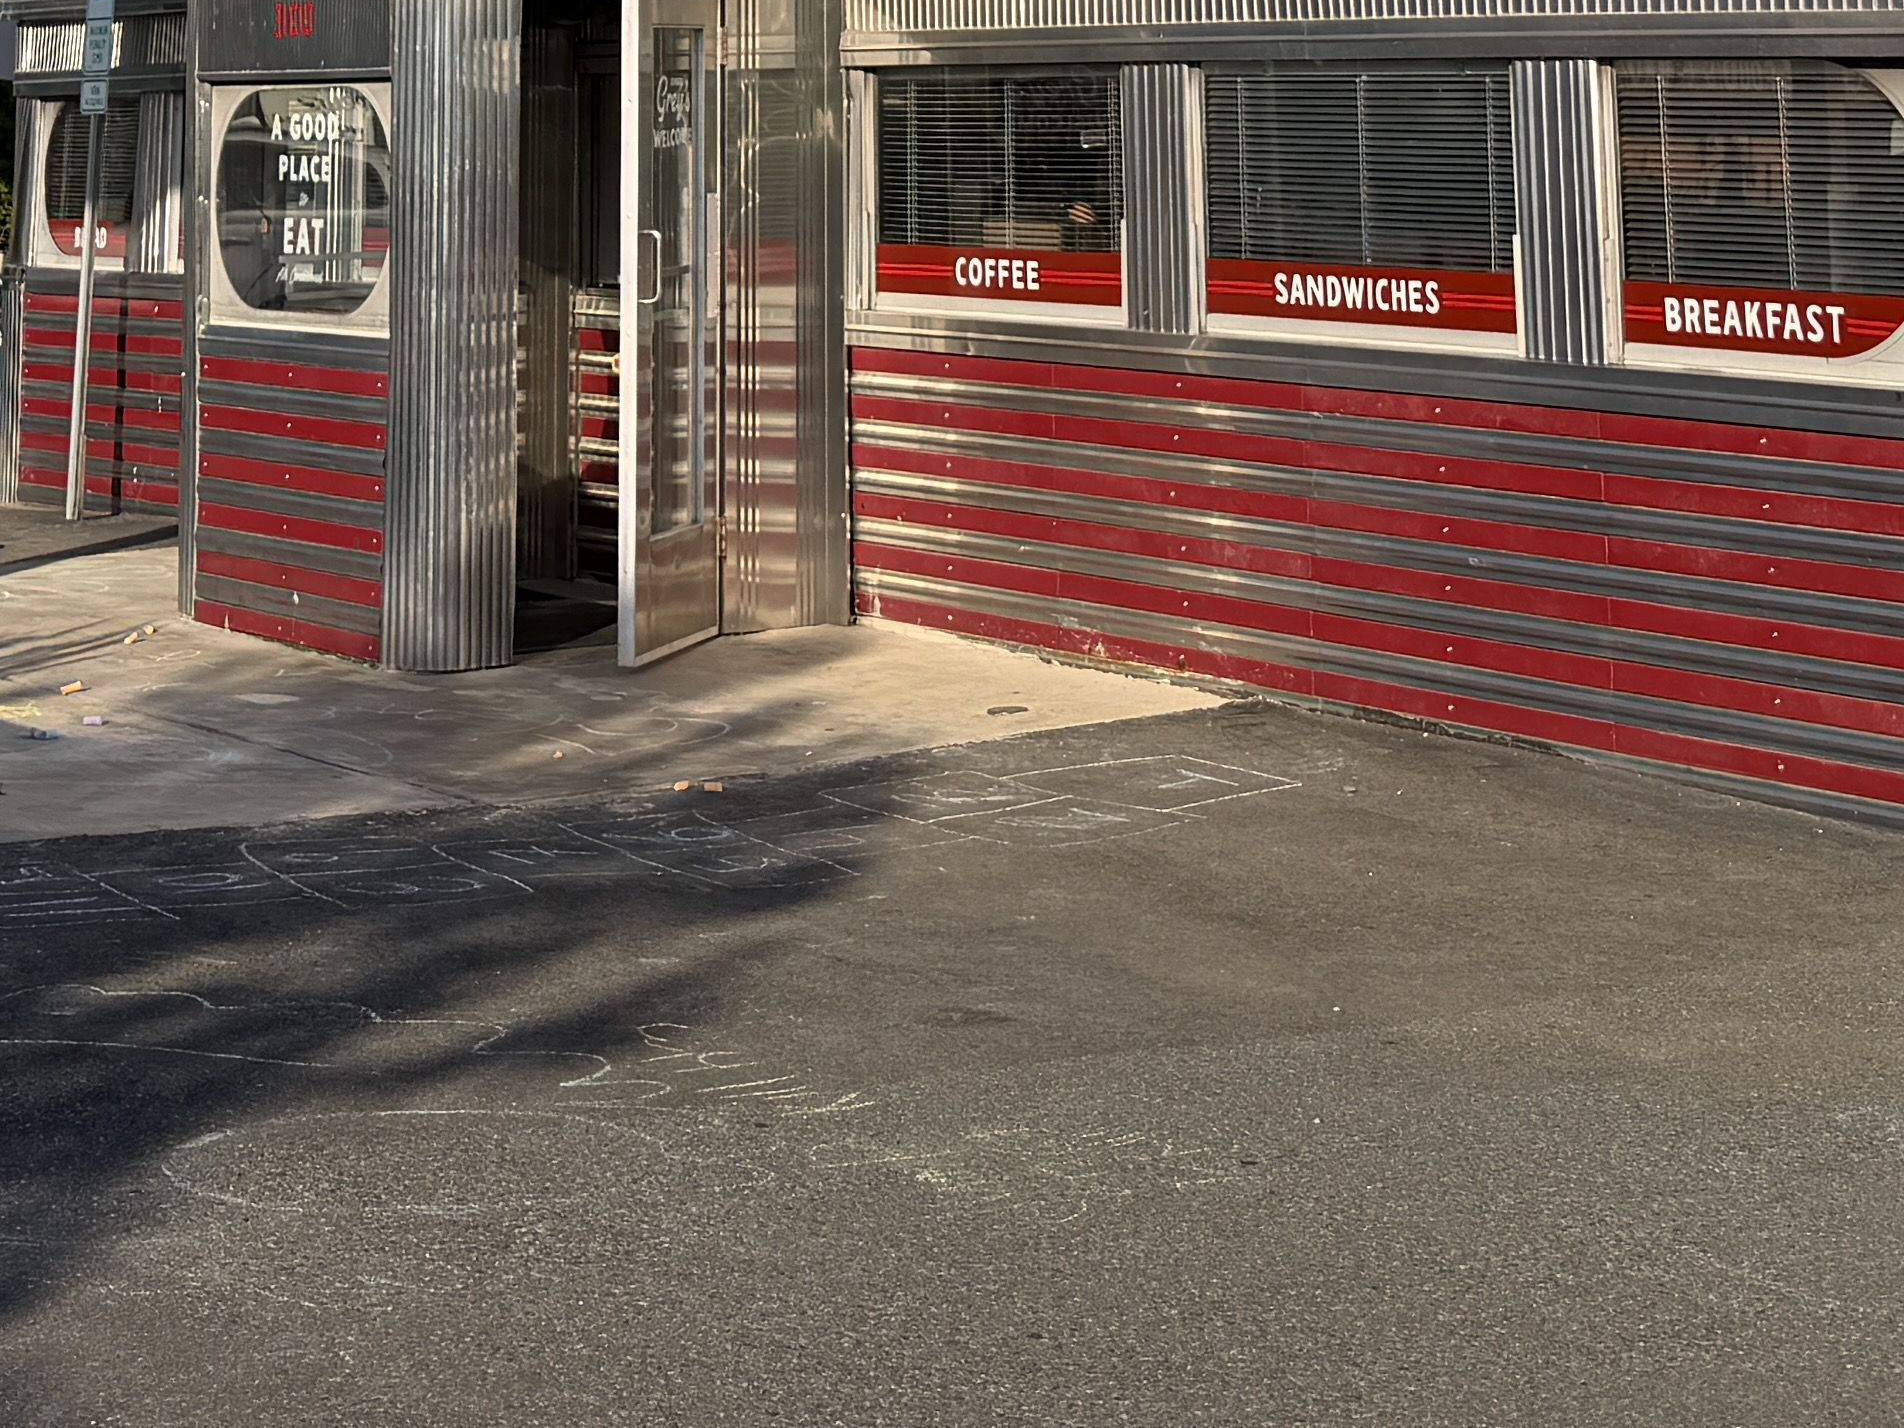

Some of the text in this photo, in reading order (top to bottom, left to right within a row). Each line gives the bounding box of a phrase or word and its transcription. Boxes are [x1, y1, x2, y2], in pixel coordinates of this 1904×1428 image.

[271, 112, 340, 141] A GOOD
[279, 154, 331, 183] PLACE
[283, 217, 324, 255] EAT
[955, 256, 1040, 291] COFFEE
[1274, 272, 1440, 314] SANDWICHES
[1664, 296, 1845, 344] BREAKFAST
